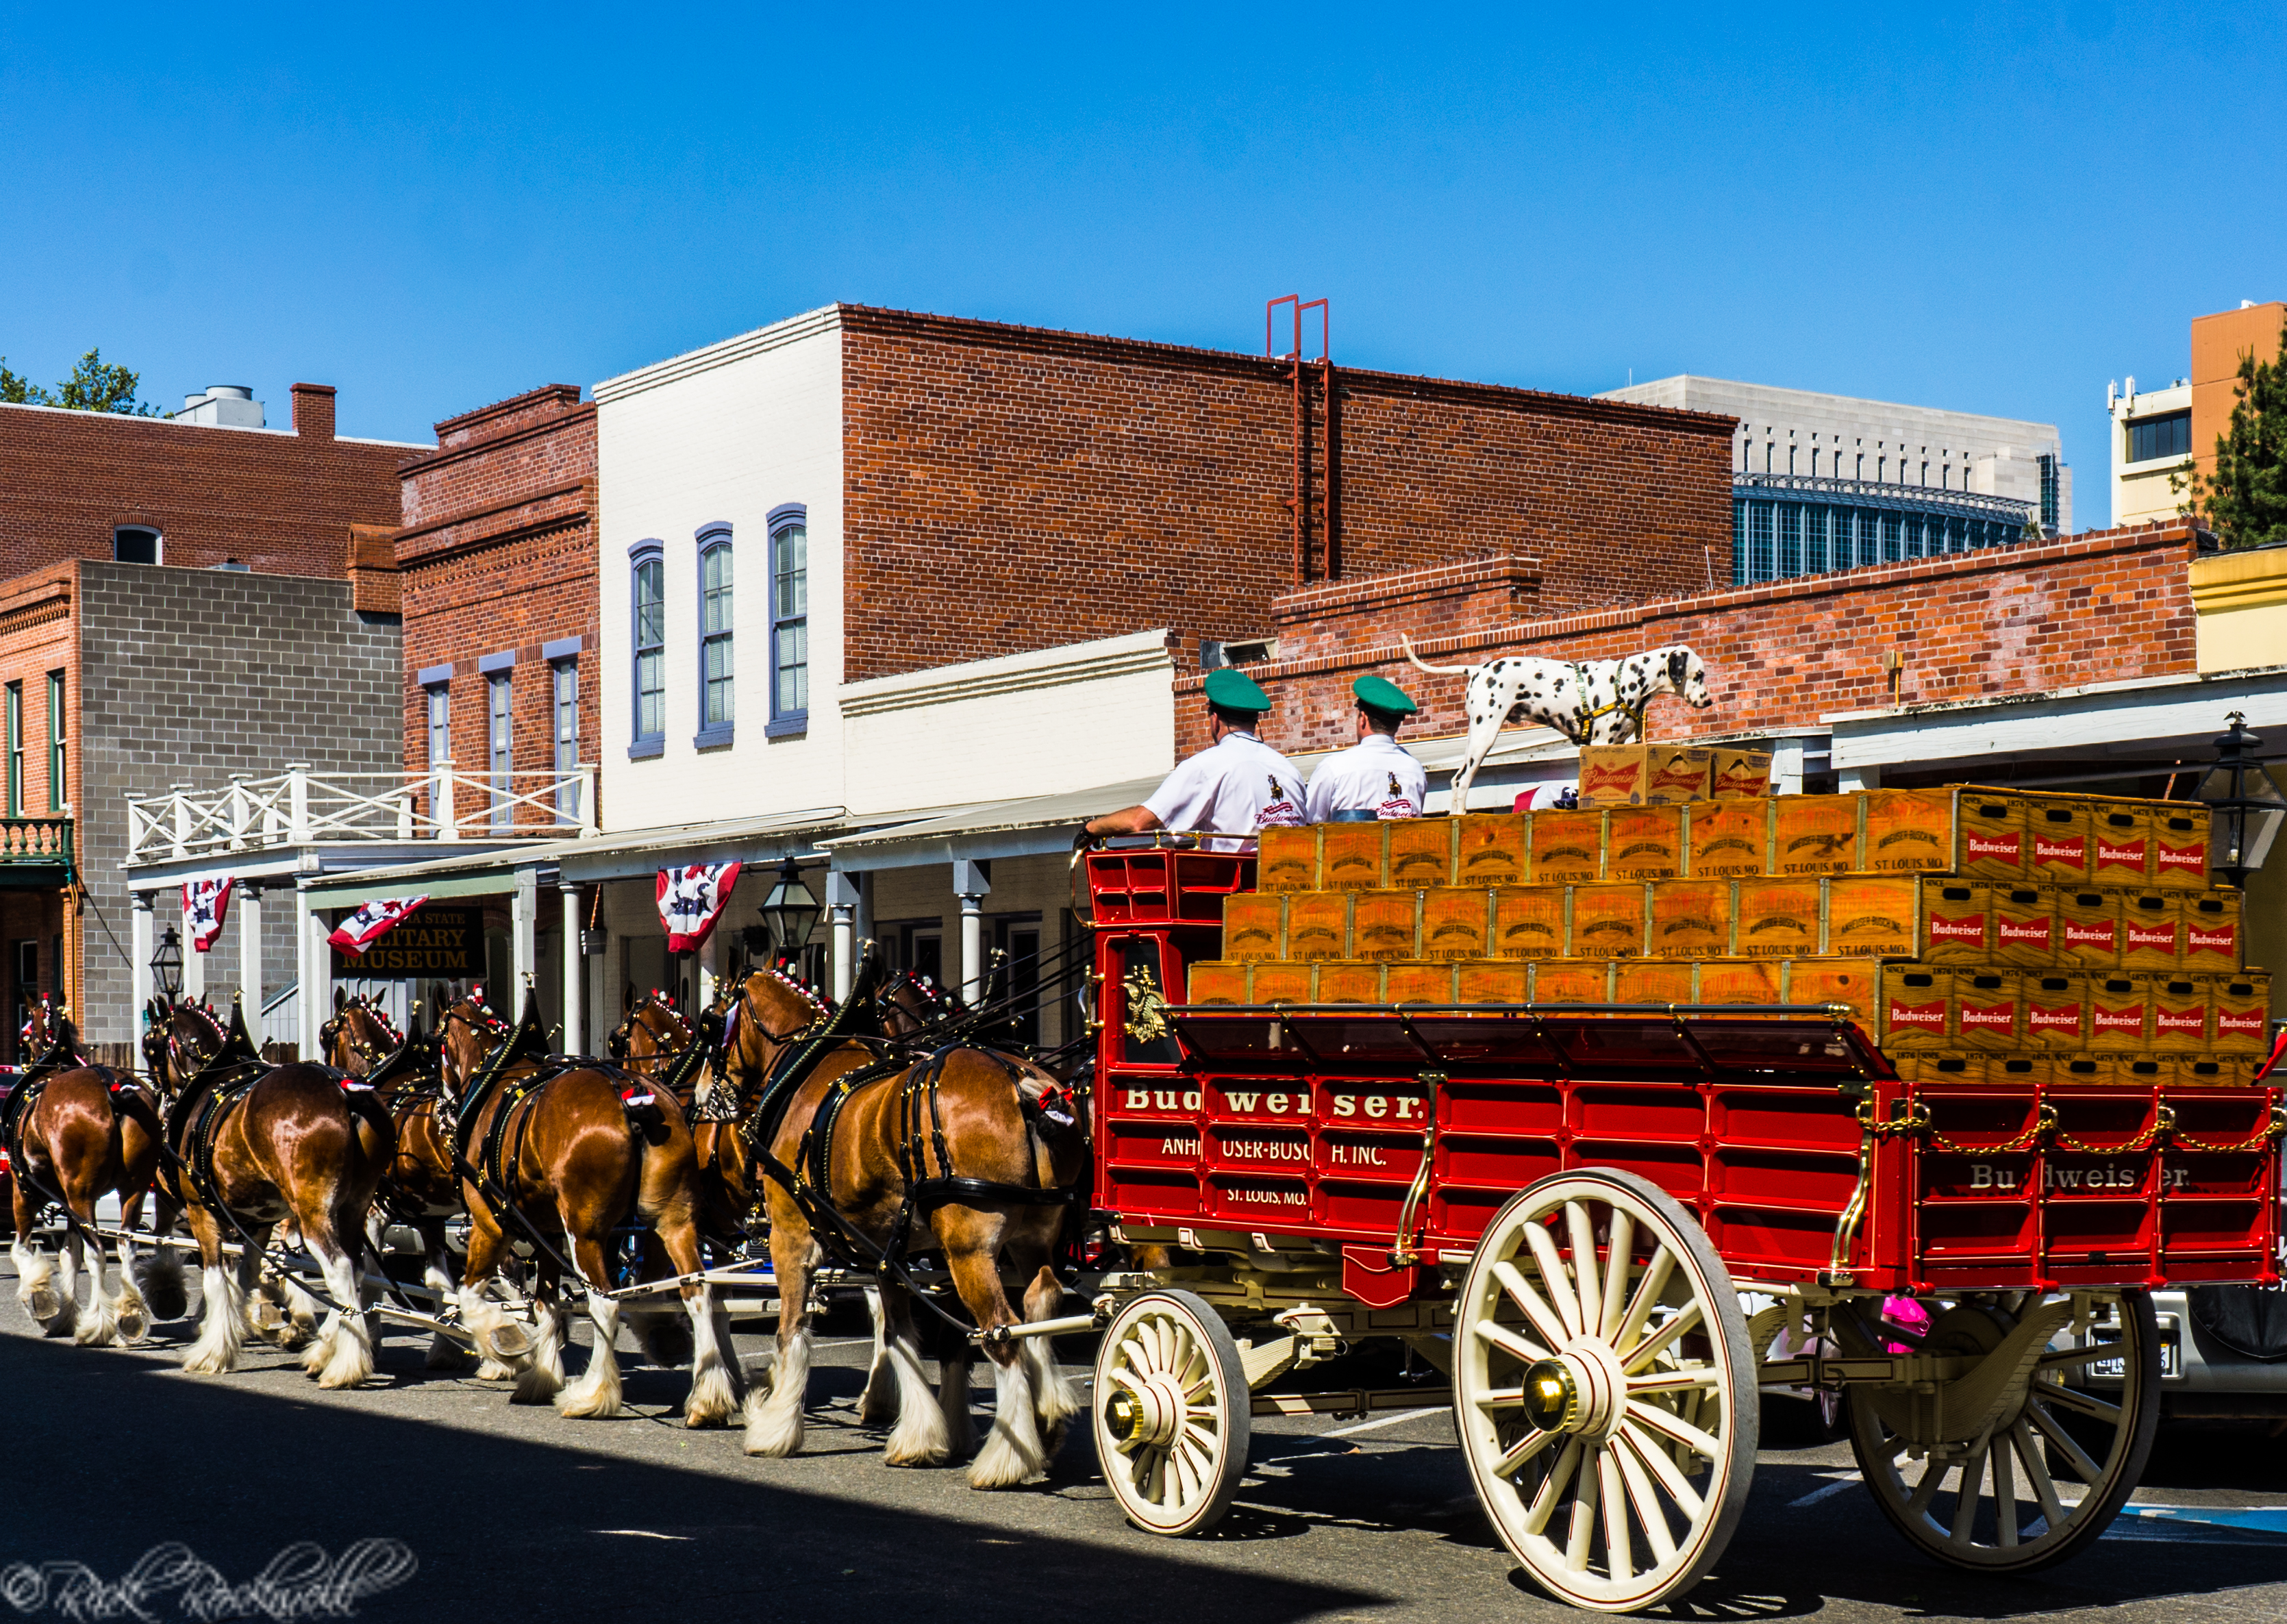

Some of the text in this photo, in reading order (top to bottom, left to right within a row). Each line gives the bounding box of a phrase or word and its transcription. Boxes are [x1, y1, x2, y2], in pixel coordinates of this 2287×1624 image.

[1582, 769, 1640, 786] Budweiser
[1649, 771, 1705, 786] Budweiser
[1969, 838, 2018, 853] Budweiser
[2036, 842, 2083, 857] Budweiser
[2099, 846, 2143, 861] Budweiser
[2160, 850, 2203, 864] Budweiser
[425, 912, 465, 924] STATE
[1932, 921, 1982, 936] Budweiser
[2000, 924, 2048, 938] Budweiser
[2066, 927, 2112, 941] Budweiser
[371, 929, 466, 947] LITARY
[2129, 929, 2173, 943] Budweiser
[2190, 932, 2233, 945] Budweiser
[342, 950, 468, 969] MUSEUM
[1892, 1008, 1944, 1022] Budweiser
[1962, 1010, 2012, 1023] Budweiser
[2030, 1011, 2078, 1025] Budweiser
[2095, 1013, 2142, 1026] Budweiser
[2158, 1014, 2202, 1027] Budweiser
[2219, 1016, 2262, 1028] Budweiser
[1351, 1145, 1387, 1166] INC.
[1227, 1188, 1307, 1206] ST. LOUIS, MO.
